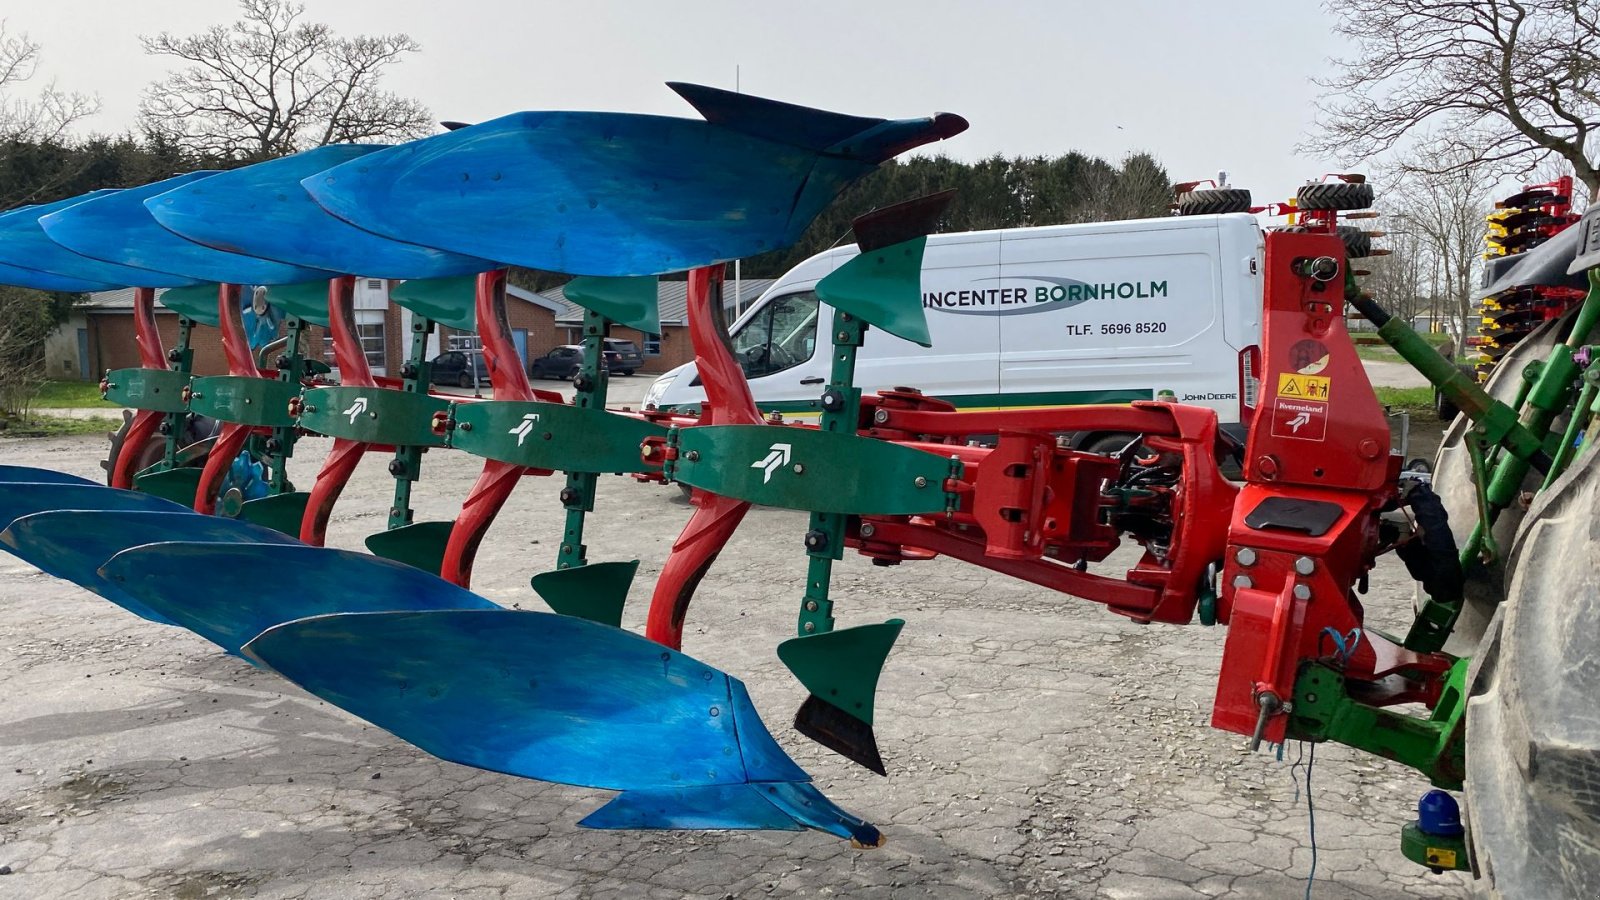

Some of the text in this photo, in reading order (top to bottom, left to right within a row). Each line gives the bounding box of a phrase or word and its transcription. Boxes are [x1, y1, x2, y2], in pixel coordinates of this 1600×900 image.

[922, 280, 1168, 308] INCENTER BORNHOLM
[1066, 322, 1167, 336] TLF. 5696 8520
[1181, 392, 1237, 401] JOHN DEERE
[1279, 402, 1323, 413] Kverneland
